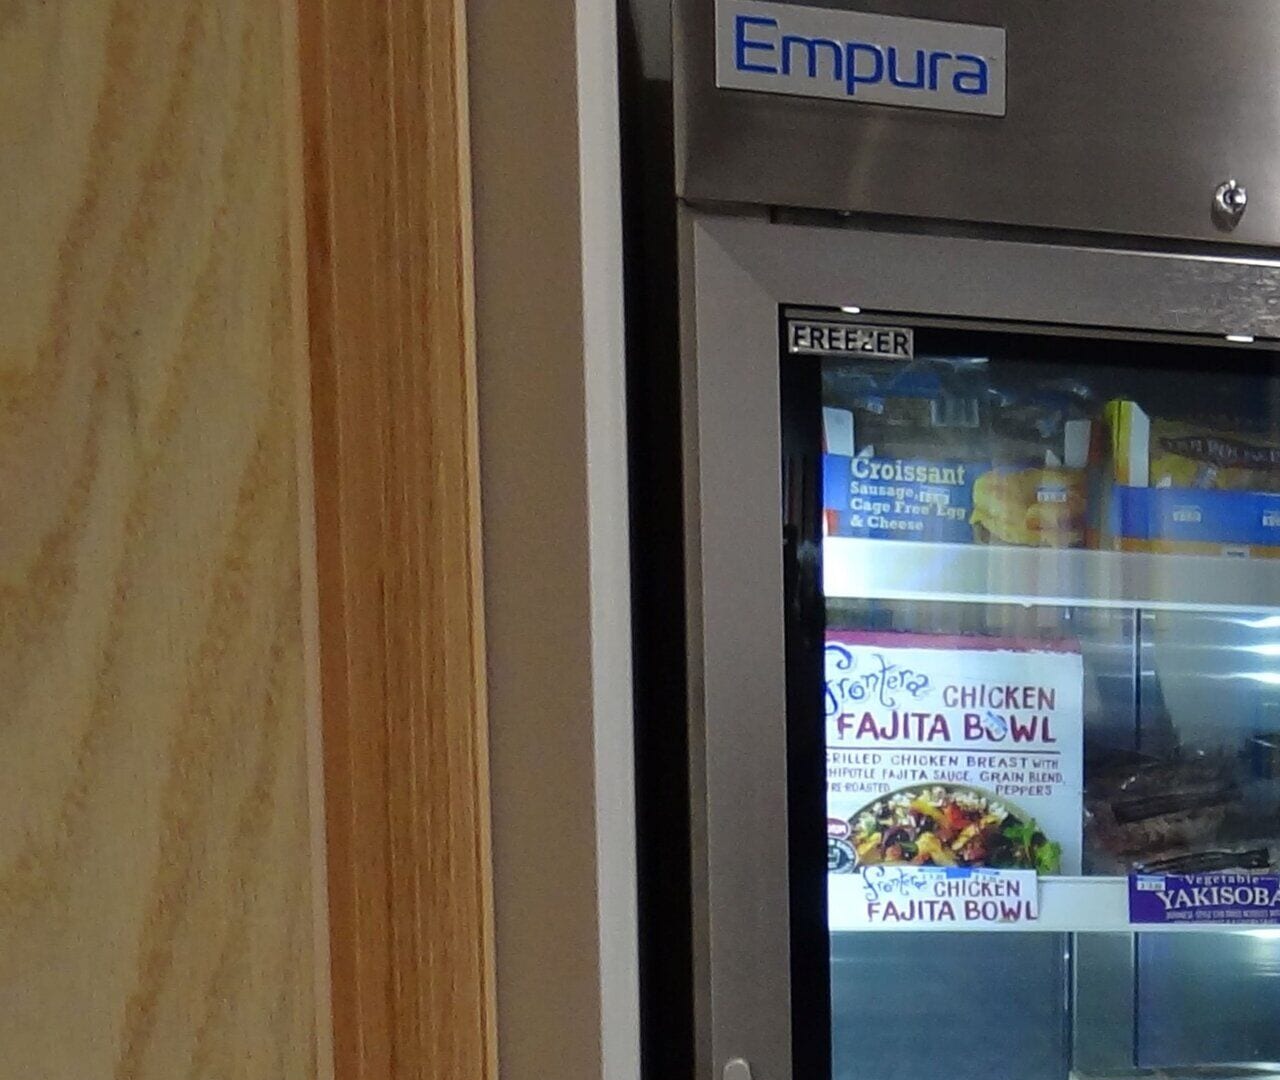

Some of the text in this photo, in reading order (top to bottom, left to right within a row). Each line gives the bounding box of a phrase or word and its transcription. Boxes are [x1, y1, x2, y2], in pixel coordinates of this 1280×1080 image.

[735, 15, 988, 95] Empura
[850, 458, 966, 486] Croissant
[850, 498, 891, 515] Cage
[894, 501, 930, 515] Free
[850, 514, 925, 530] & Cheese
[943, 684, 1056, 711] CHICKEN
[837, 711, 1058, 743] FAJITA BOWL
[890, 754, 959, 767] CHICKEN
[966, 756, 1029, 770] BREAST
[1032, 759, 1059, 770] WITH
[828, 767, 875, 779] HIPOTLE
[882, 769, 928, 781] FAJITA
[979, 771, 1025, 784] GRAIN
[995, 784, 1053, 797] PEPPERS
[1184, 874, 1260, 886] Vegetable
[934, 880, 1021, 898] CHICKEN
[867, 900, 1039, 921] FAJITA BOWL
